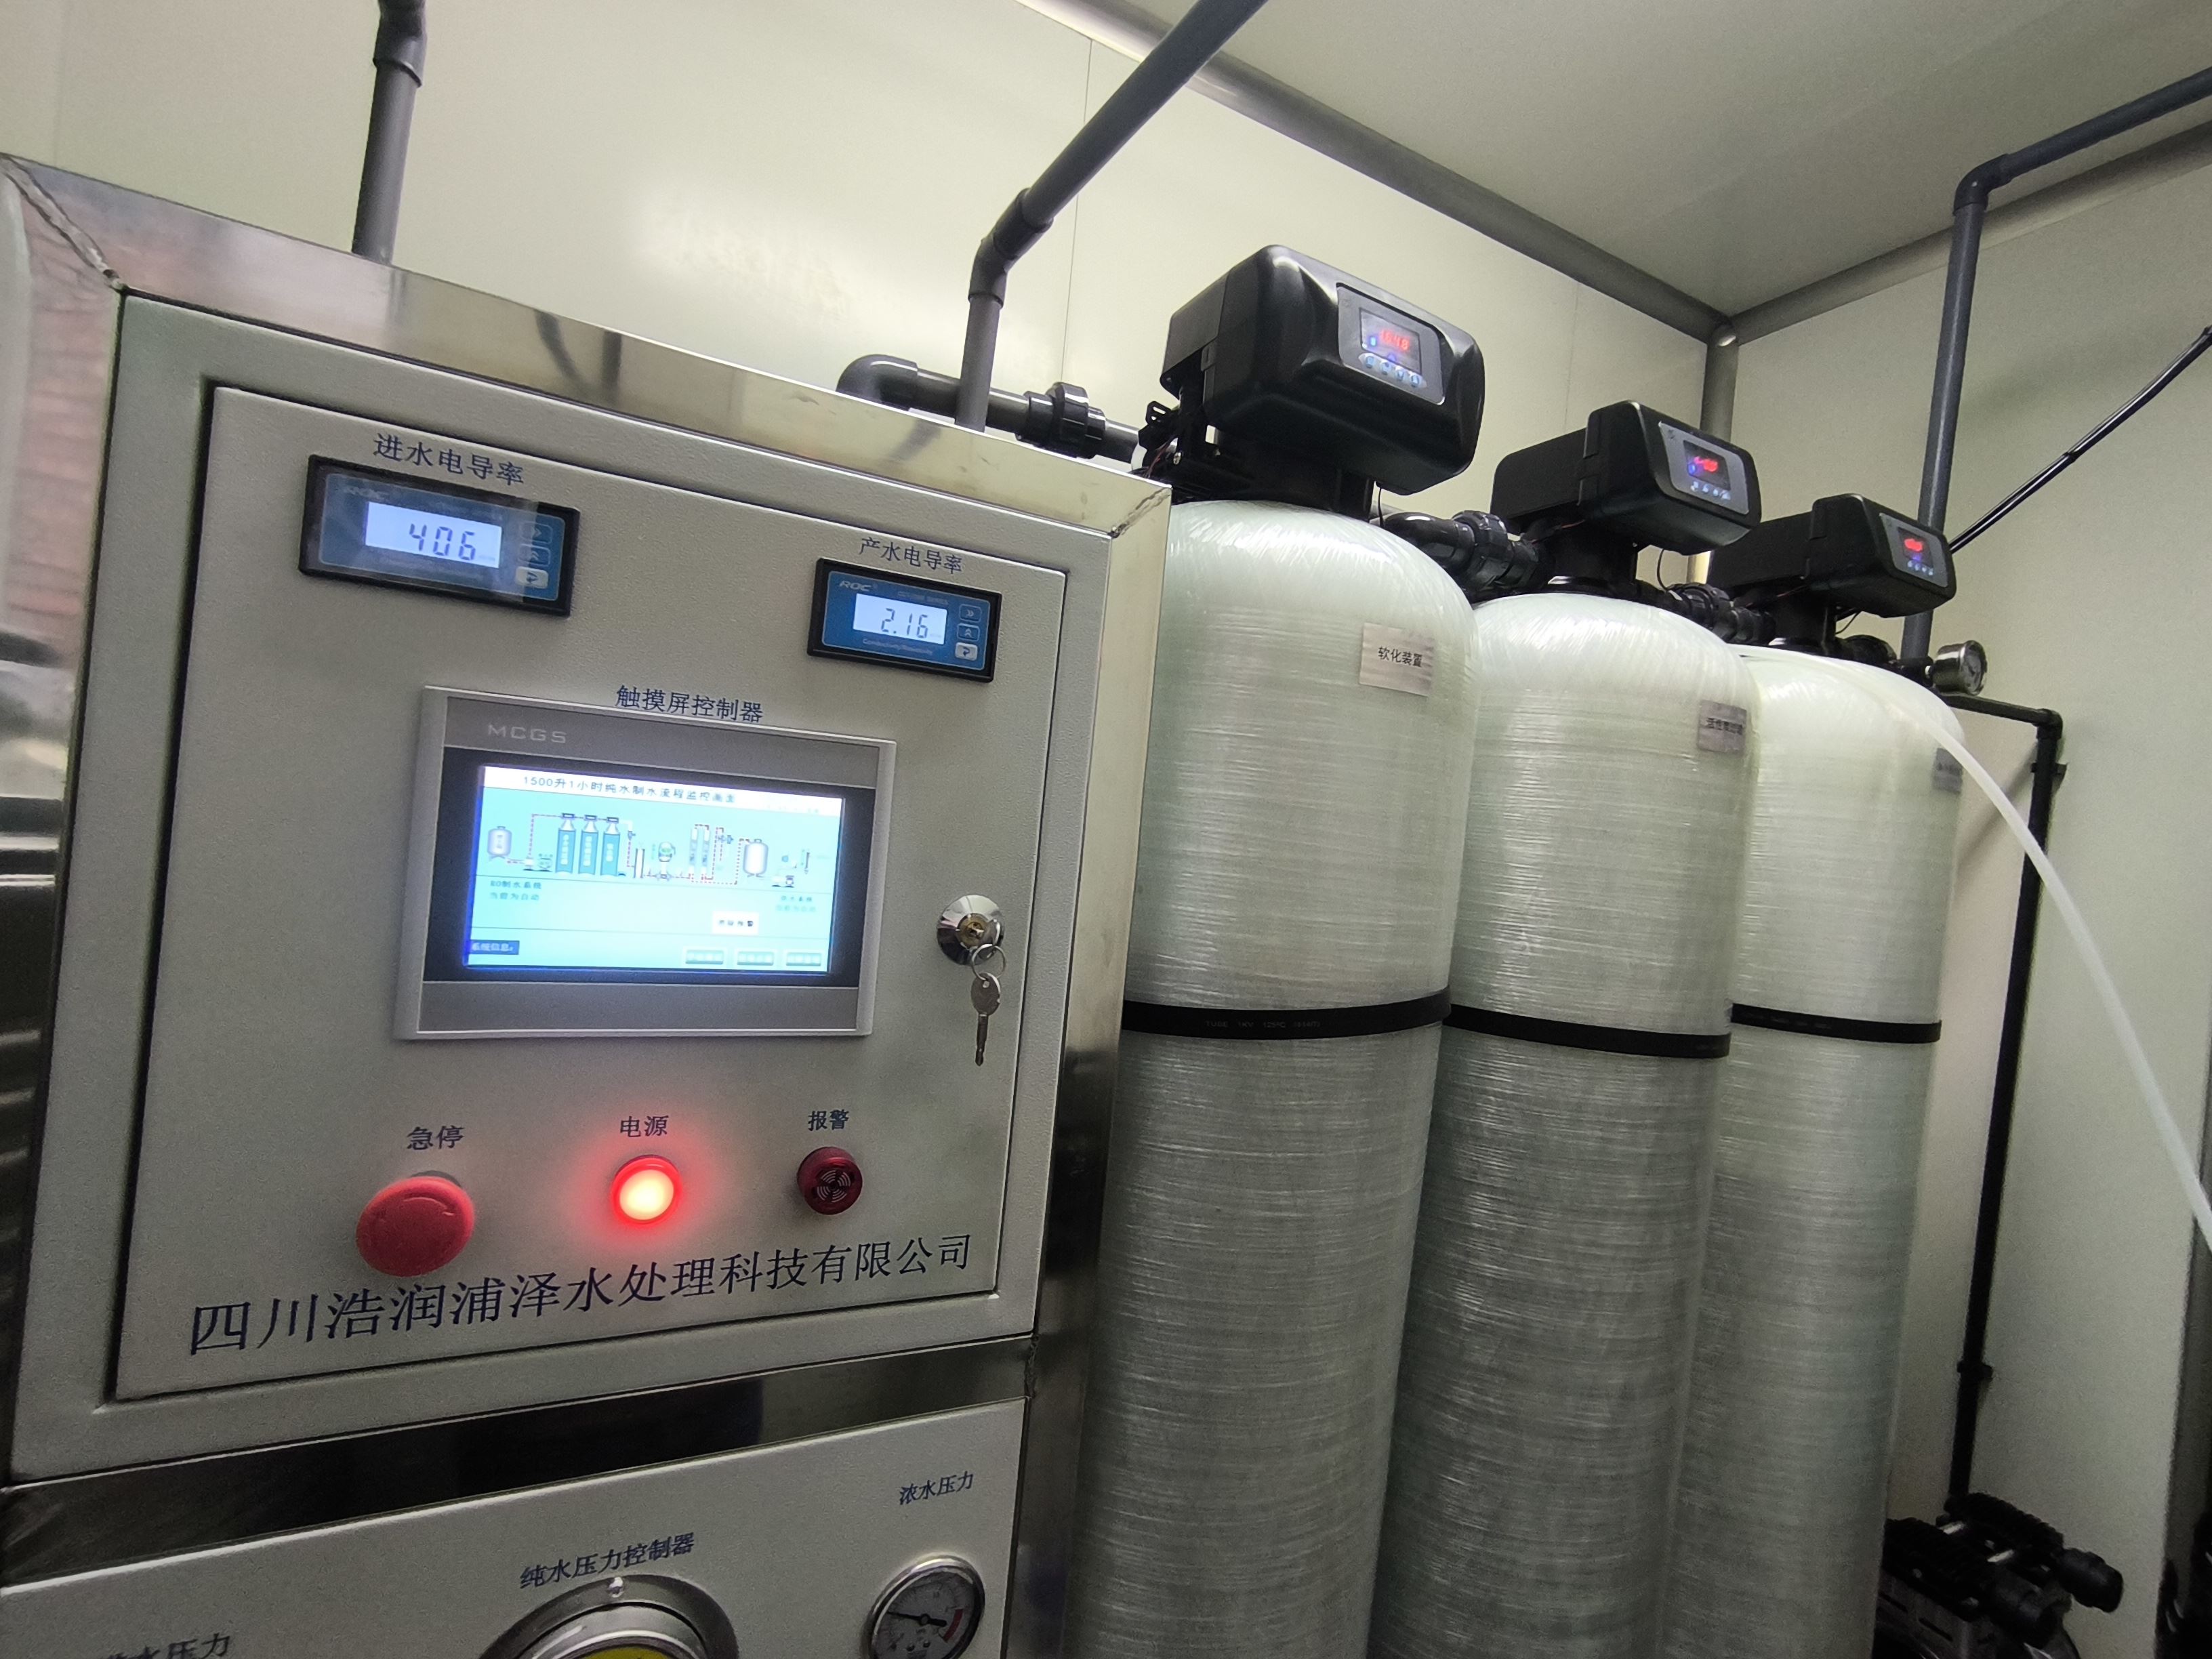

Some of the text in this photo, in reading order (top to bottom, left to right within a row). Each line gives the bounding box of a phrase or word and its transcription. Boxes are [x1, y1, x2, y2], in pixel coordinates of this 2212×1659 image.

[373, 432, 525, 486] 进水电导率
[408, 523, 476, 561] 406
[858, 536, 963, 574] 产水电导率
[839, 579, 873, 592] ROC
[881, 607, 928, 638] 2.16
[1378, 647, 1423, 668] 软化装置
[615, 684, 764, 723] 触摸屏控制器
[488, 724, 567, 743] MCGS
[619, 1114, 670, 1139] 电源
[807, 1109, 850, 1131] 报警
[406, 1125, 464, 1151] 急停
[190, 1233, 972, 1355] 四川浩润浦泽水处理科技有限公司
[899, 1470, 974, 1505] 浓水压力
[520, 1532, 695, 1589] 纯水压力控制器
